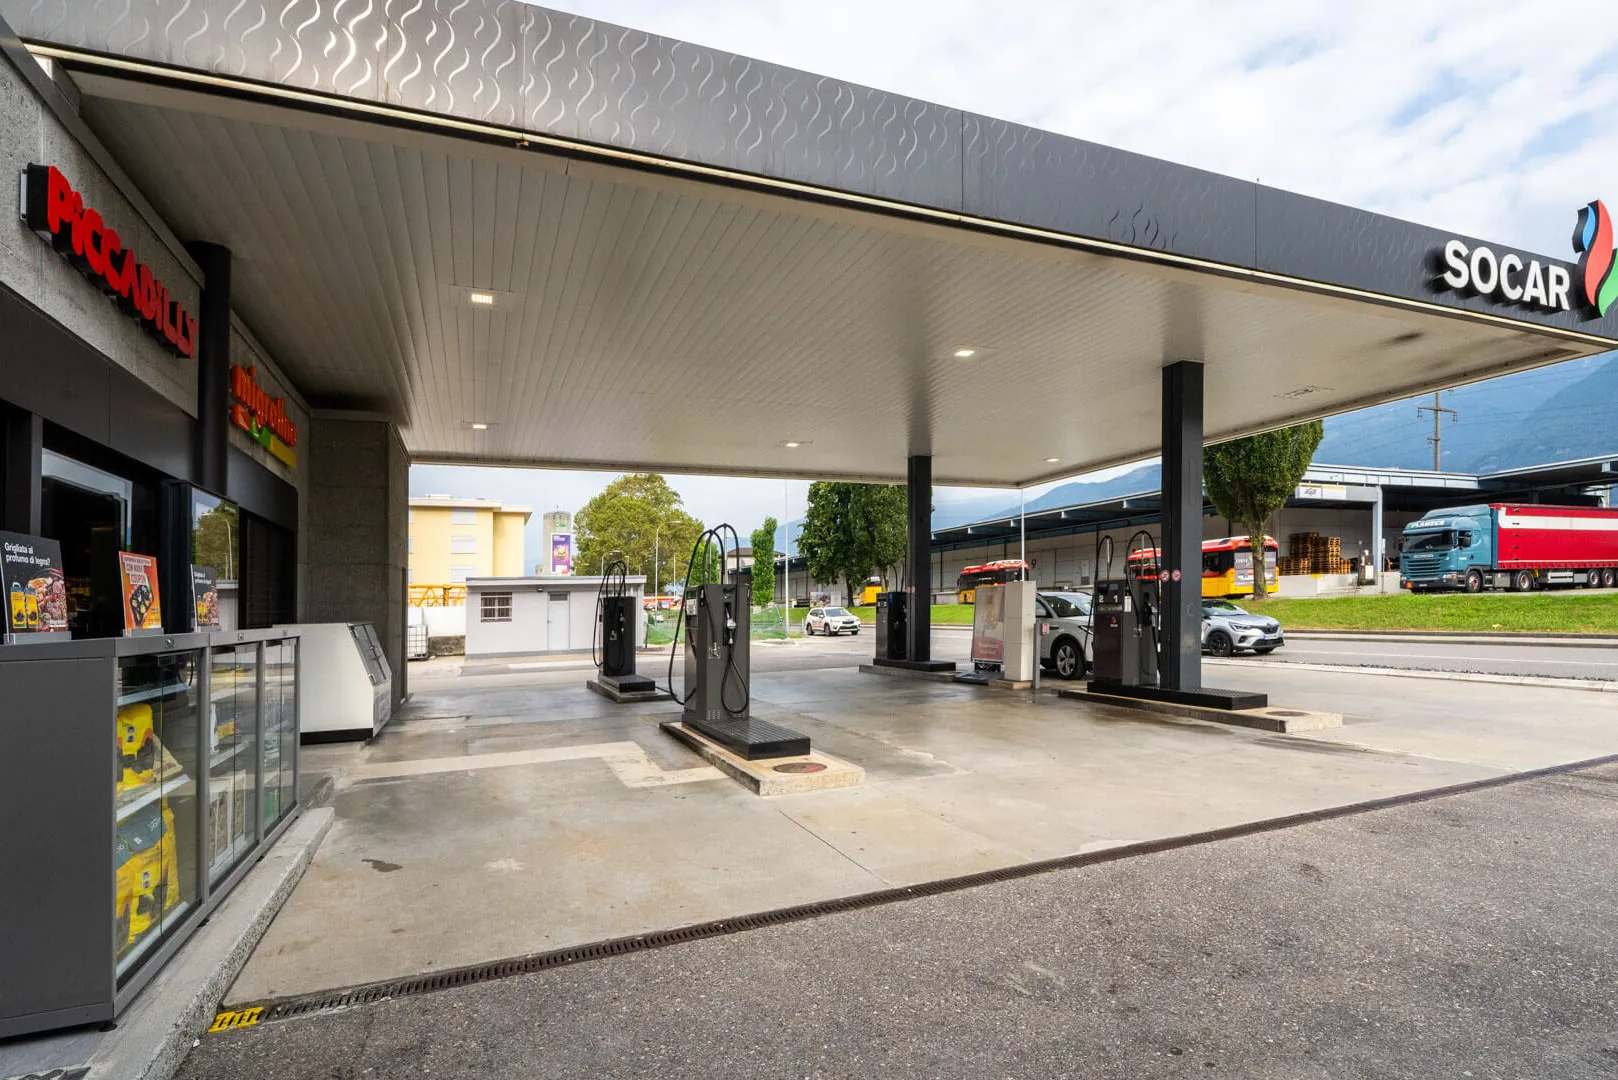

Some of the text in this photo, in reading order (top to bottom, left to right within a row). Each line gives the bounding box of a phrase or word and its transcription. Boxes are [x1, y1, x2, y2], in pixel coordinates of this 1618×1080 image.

[1444, 240, 1570, 311] SOCAR
[4, 542, 34, 554] Grigliata al
[5, 554, 29, 563] profumo
[29, 555, 35, 564] di
[1098, 594, 1118, 603] 2 1
